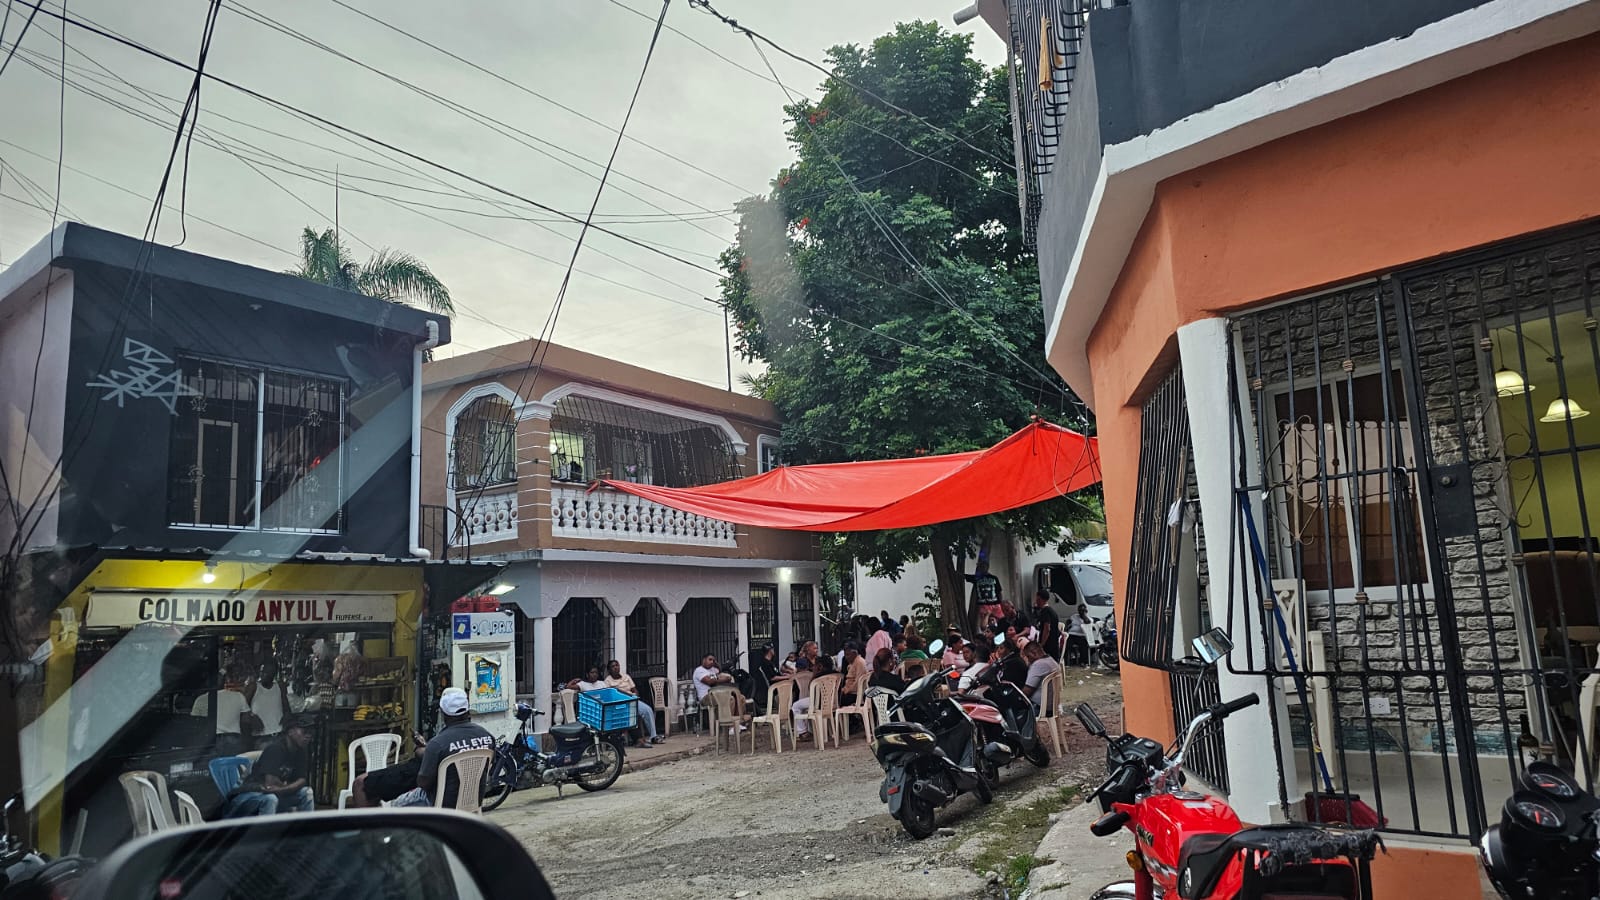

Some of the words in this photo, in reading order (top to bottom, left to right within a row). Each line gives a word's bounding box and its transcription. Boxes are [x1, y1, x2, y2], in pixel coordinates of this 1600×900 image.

[139, 597, 245, 622] COLMADO
[255, 599, 336, 622] ANYULY
[449, 739, 470, 752] ALL
[470, 735, 493, 747] EYES
